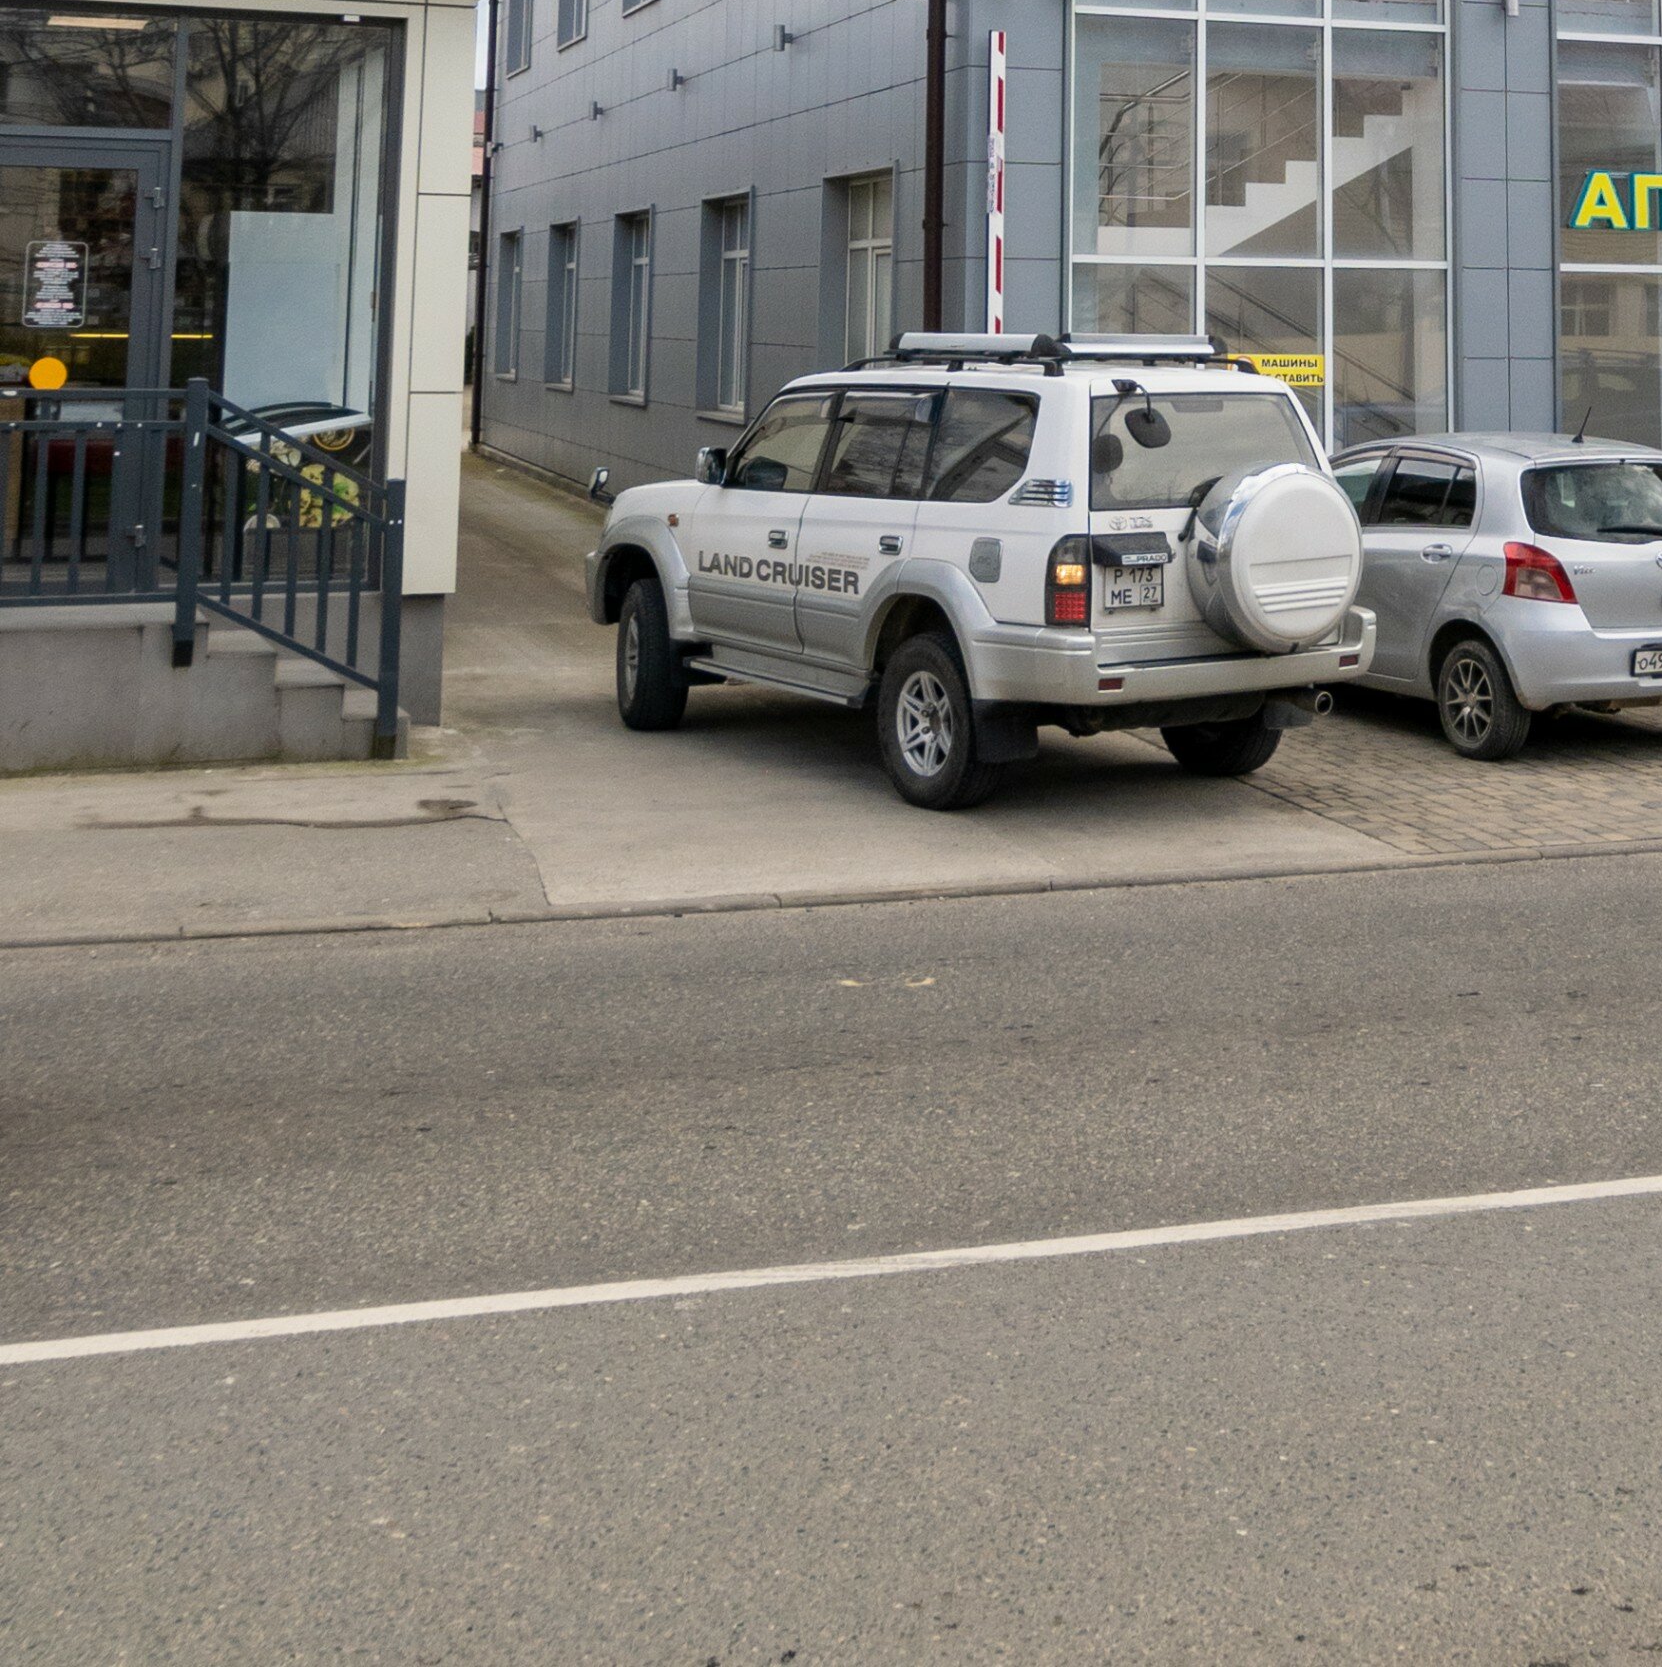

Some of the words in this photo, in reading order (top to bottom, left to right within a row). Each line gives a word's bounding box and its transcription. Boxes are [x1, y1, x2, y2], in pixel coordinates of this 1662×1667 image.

[1261, 359, 1318, 368] МАШИНЫ
[1136, 554, 1167, 563] PRADO
[698, 550, 753, 579] LAND
[756, 559, 859, 595] CRUISER
[1143, 586, 1157, 599] 27
